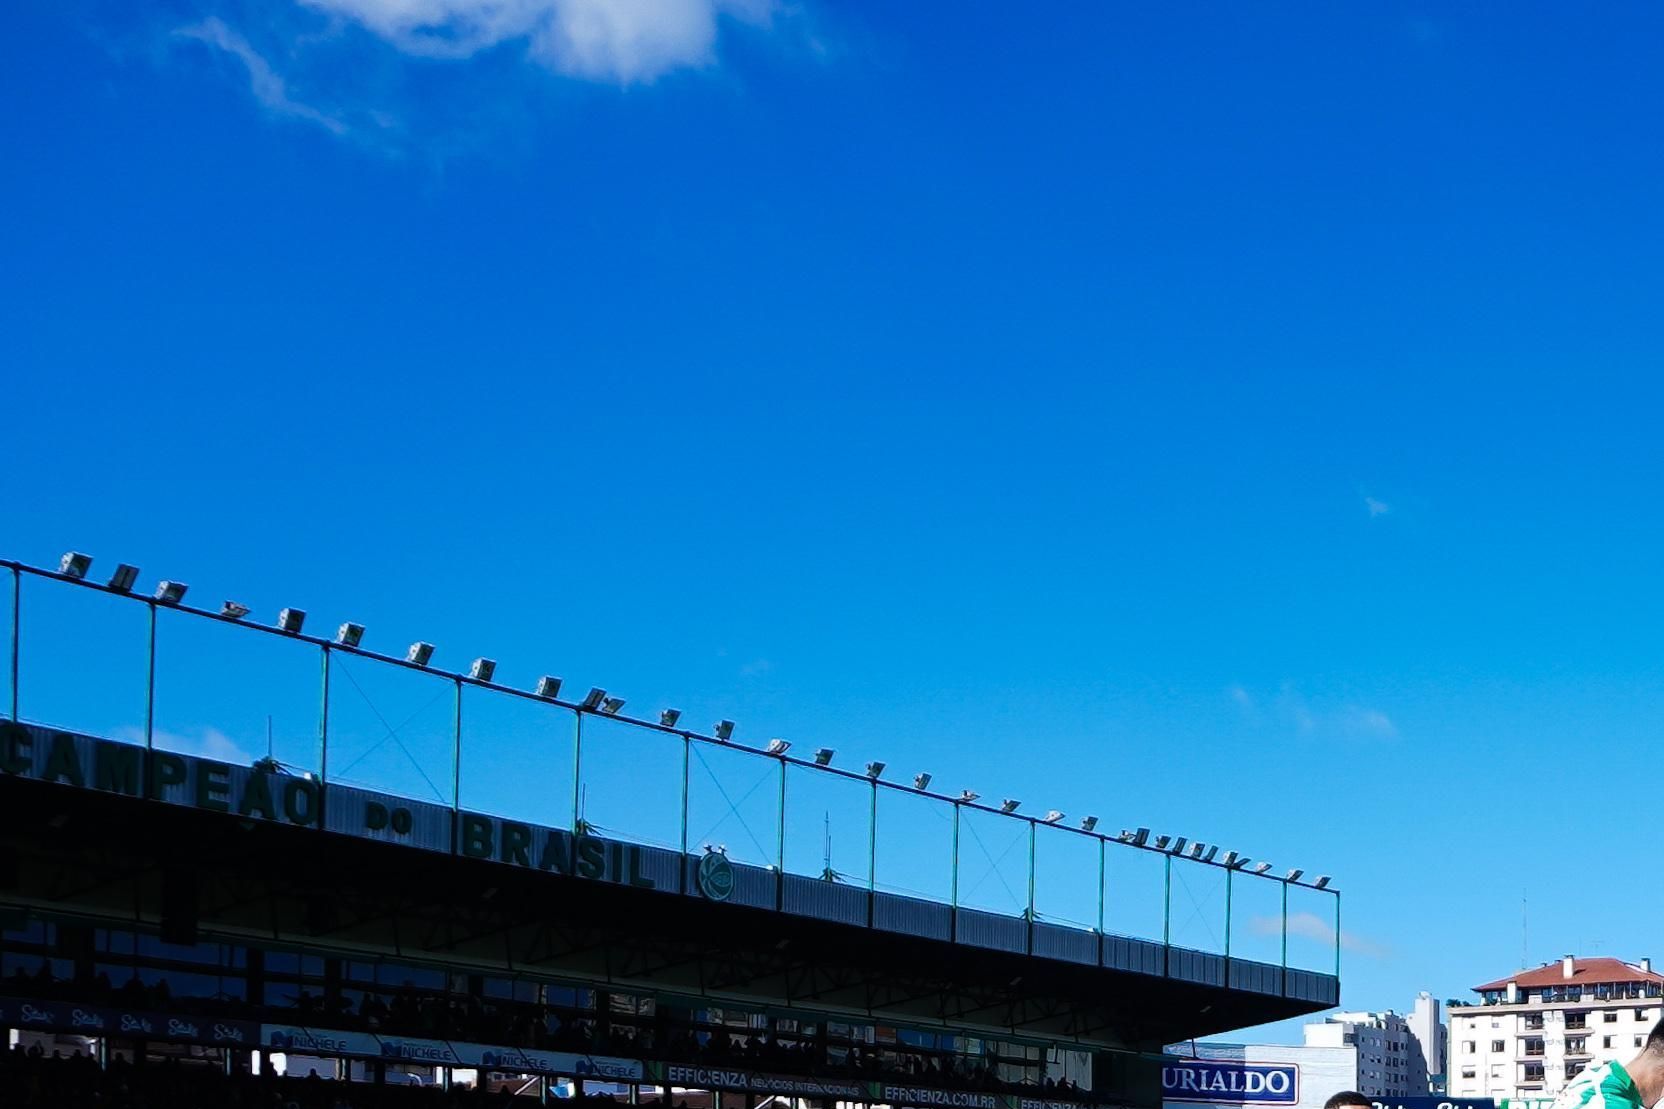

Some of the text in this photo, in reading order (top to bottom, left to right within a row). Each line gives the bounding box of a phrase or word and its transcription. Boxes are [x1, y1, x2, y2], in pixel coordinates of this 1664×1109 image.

[364, 801, 412, 834] DO
[462, 811, 655, 890] BRASIL
[668, 1066, 747, 1089] EFFICIENZA
